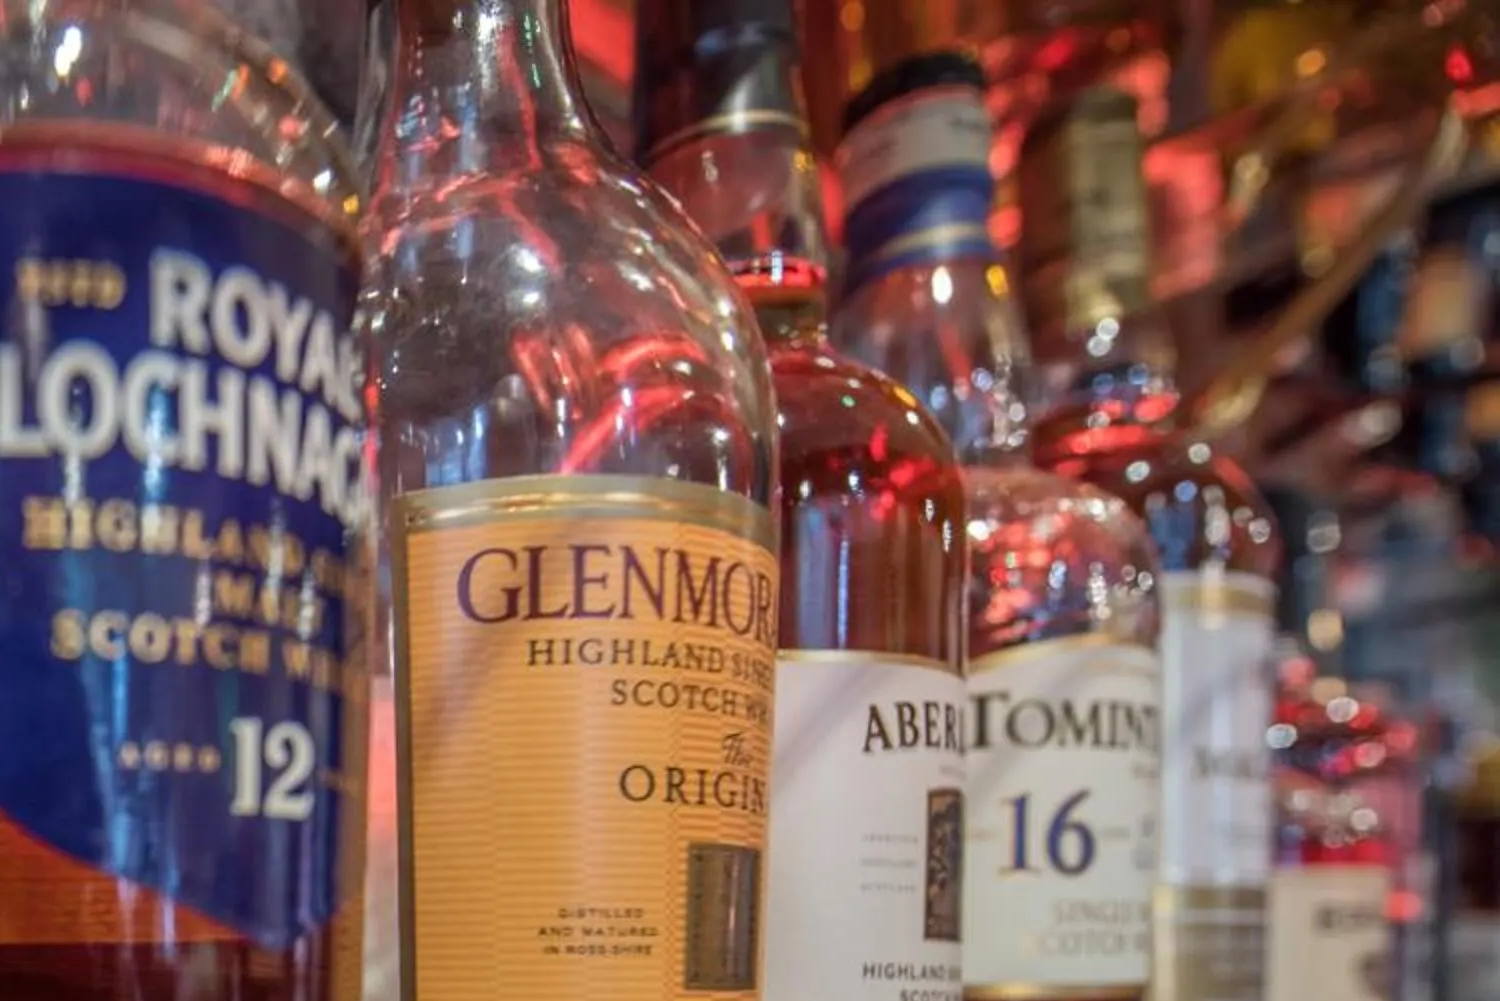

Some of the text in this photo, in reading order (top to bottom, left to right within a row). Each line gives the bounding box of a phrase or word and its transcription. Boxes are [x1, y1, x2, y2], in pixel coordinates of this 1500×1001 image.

[50, 607, 271, 674] SCOTCH
[526, 638, 725, 674] HIGHLAND
[611, 679, 737, 717] SCOTCH
[229, 716, 316, 819] 12
[619, 764, 767, 813] ORIGIN
[998, 787, 1096, 877] 16
[538, 926, 660, 938] AND MATURED
[557, 907, 645, 920] DISTILLED
